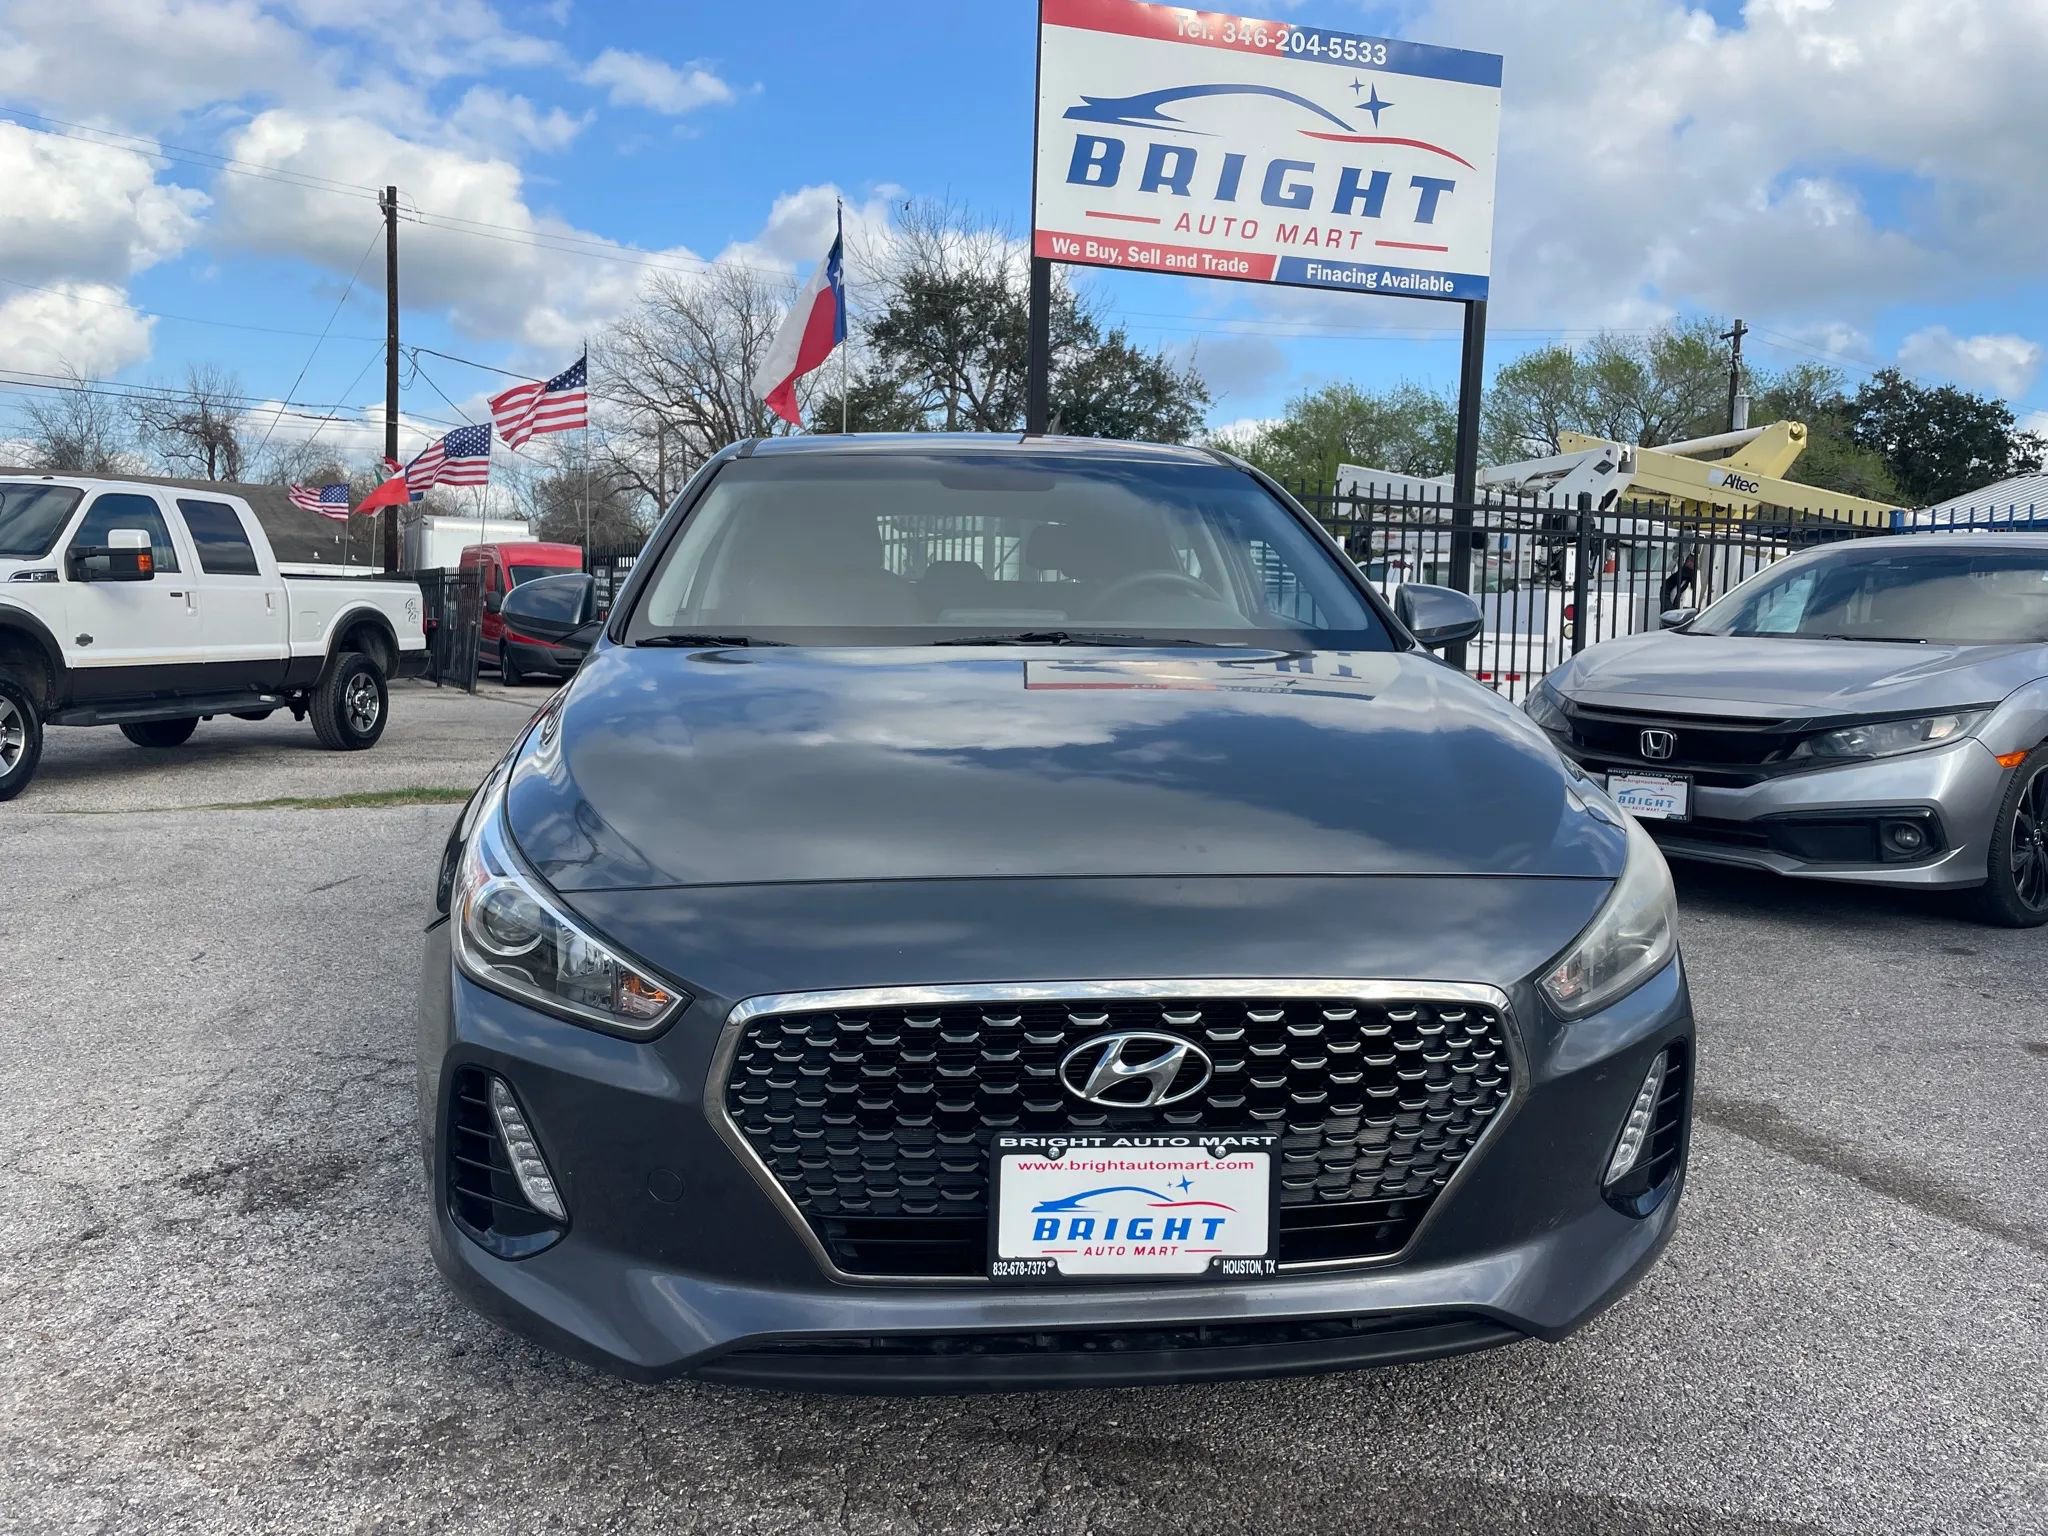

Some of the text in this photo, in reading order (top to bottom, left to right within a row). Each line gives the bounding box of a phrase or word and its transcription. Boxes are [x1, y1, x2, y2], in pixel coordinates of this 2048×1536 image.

[1174, 14, 1388, 66] Tel: 346-204-5533
[1065, 133, 1456, 225] BRIGHT
[1174, 212, 1363, 250] AUTO MART
[1051, 236, 1250, 274] We Buy, Sell and Trade
[1306, 263, 1454, 293] Finacing Available
[1721, 473, 1760, 494] Altec
[1617, 795, 1675, 808] BRIGHT
[999, 1135, 1278, 1147] BRIGHT AUTO MART
[1018, 1159, 1255, 1173] www.brightautomart.com
[1032, 1217, 1226, 1242] BRIGHT
[1083, 1246, 1179, 1257] AUTO MART
[992, 1261, 1047, 1276] 832-678-7373
[1222, 1259, 1276, 1276] HOUSTON, TX
